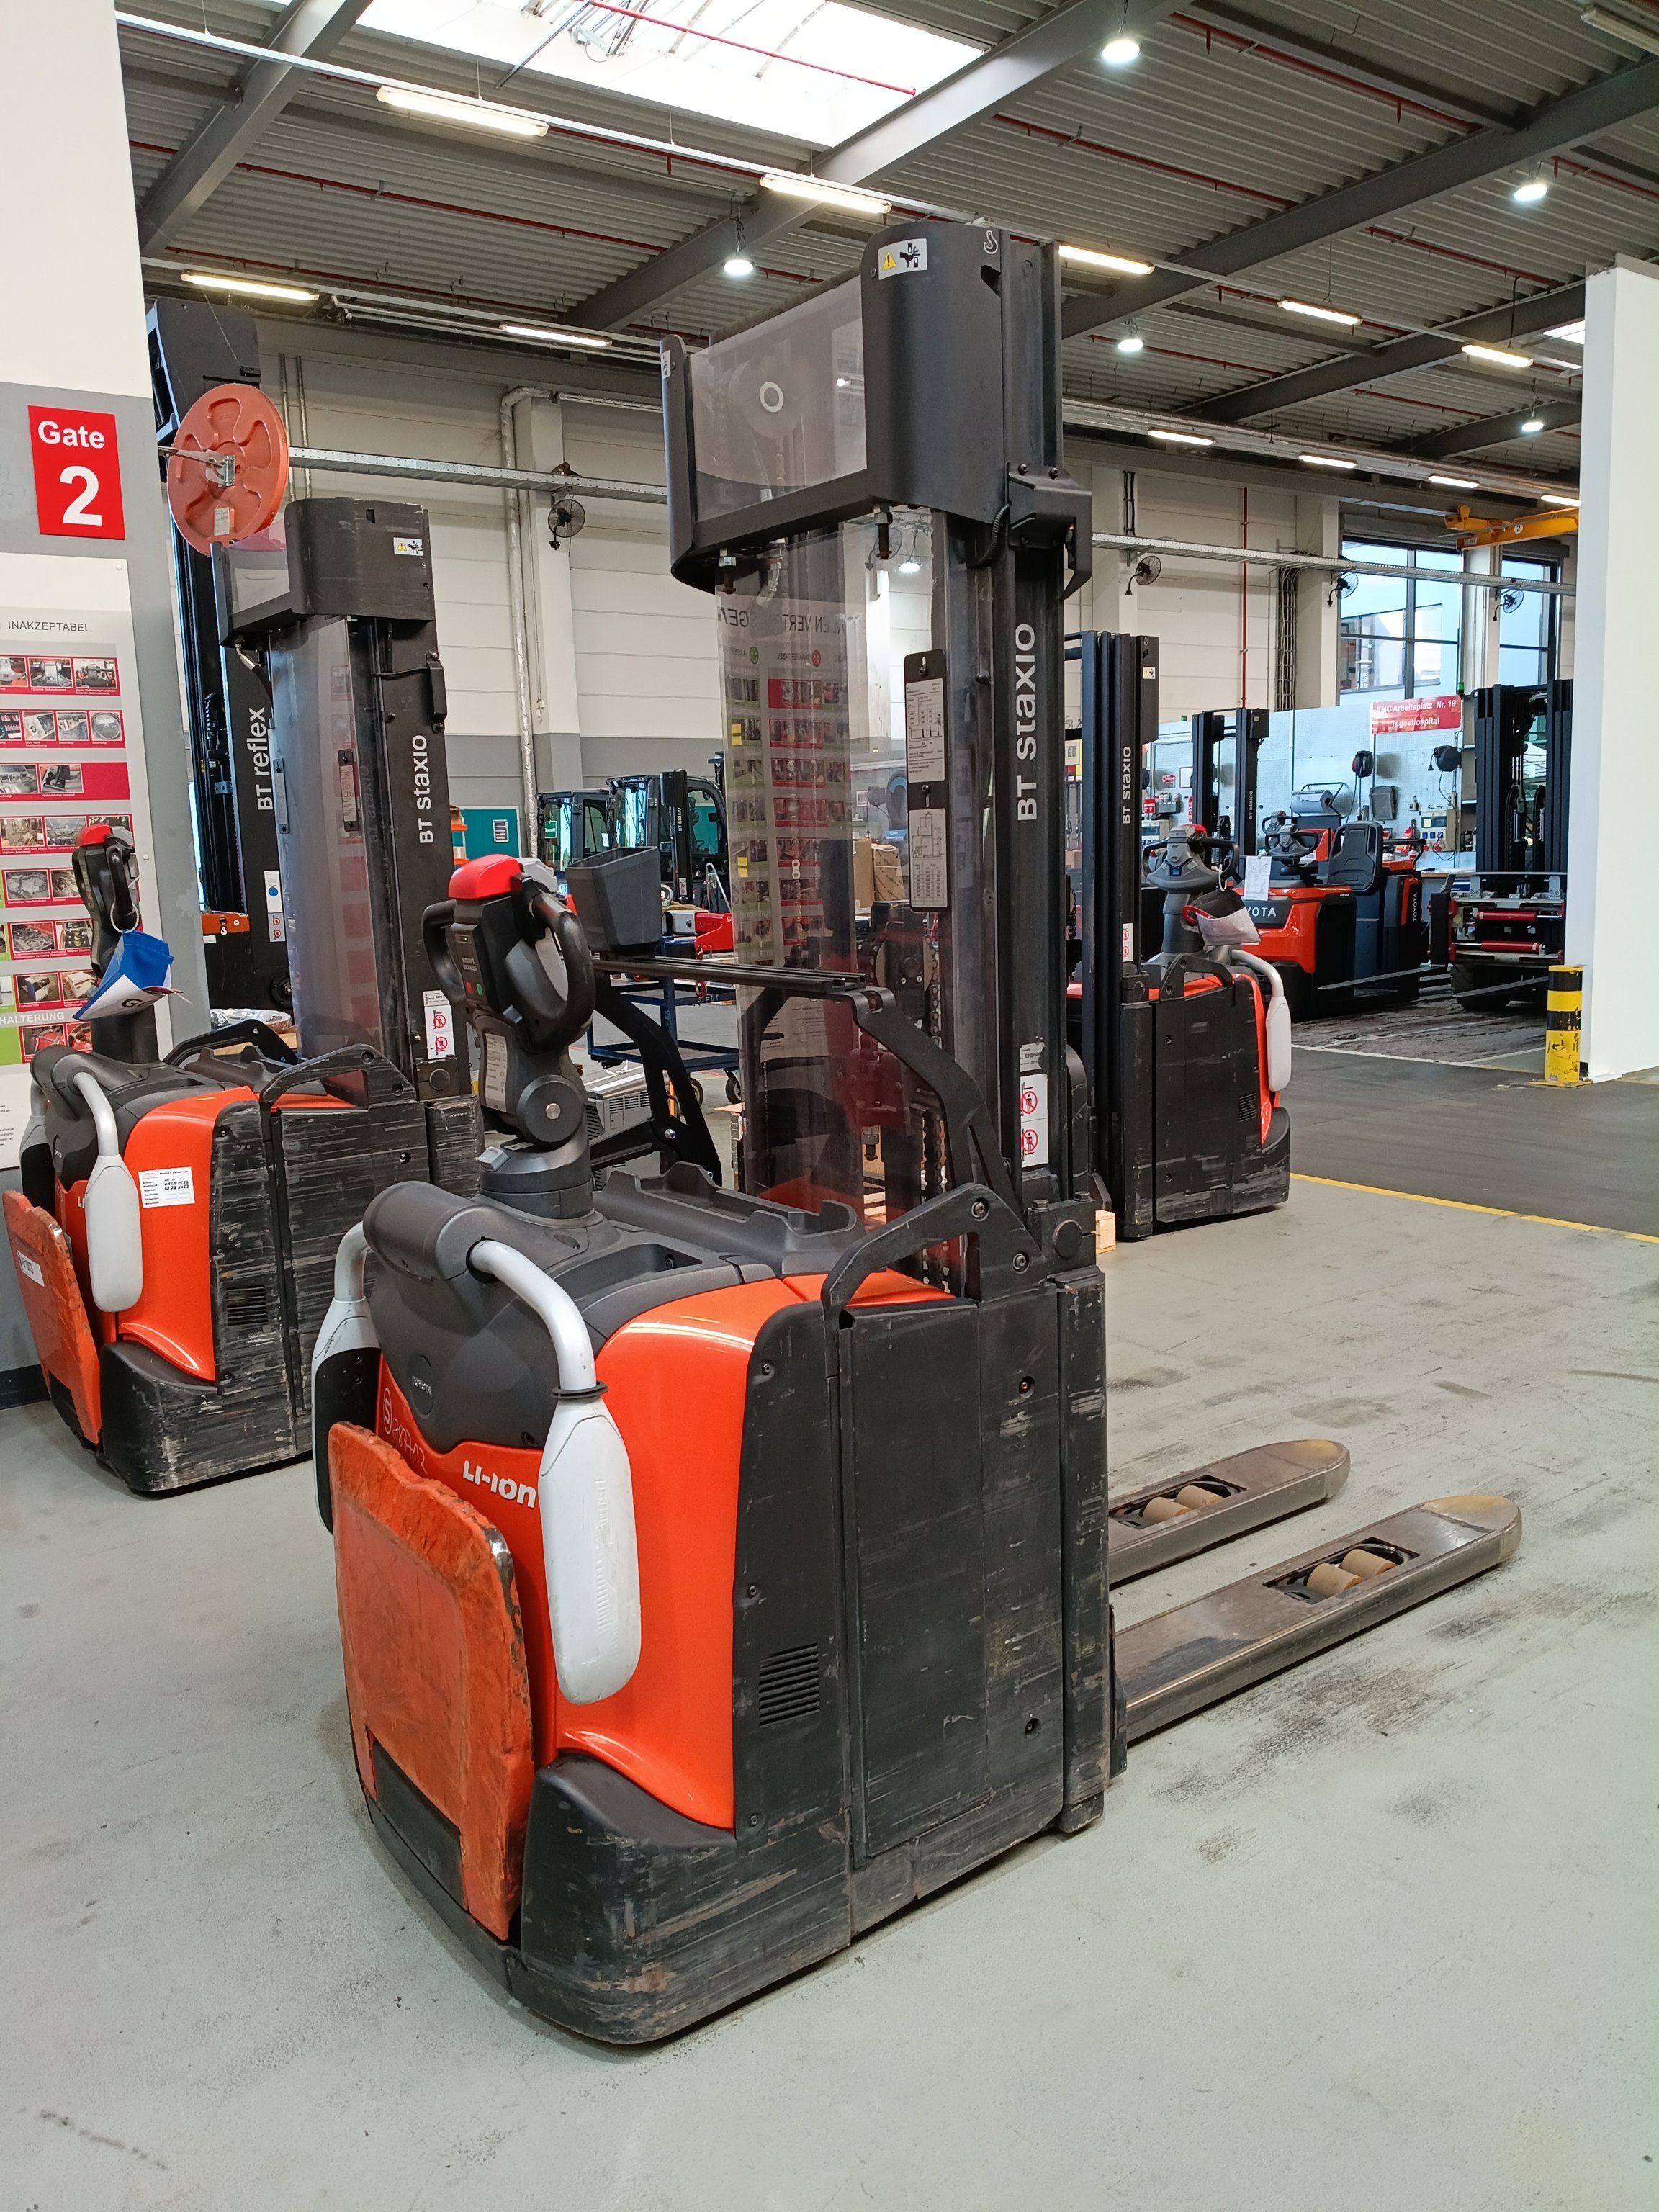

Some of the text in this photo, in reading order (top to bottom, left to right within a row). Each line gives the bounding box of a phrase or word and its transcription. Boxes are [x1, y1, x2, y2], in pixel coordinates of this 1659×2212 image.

[37, 420, 105, 449] Gate
[59, 465, 103, 526] 2
[8, 620, 91, 632] INAKZEPTABEL
[1015, 623, 1037, 821] BT staxio
[1391, 716, 1440, 728] Tageshospital
[1393, 702, 1433, 713] Arbeitsplatz
[246, 707, 274, 811] BT reflex
[412, 734, 434, 844] BT staxio
[1123, 746, 1132, 824] BT staxio
